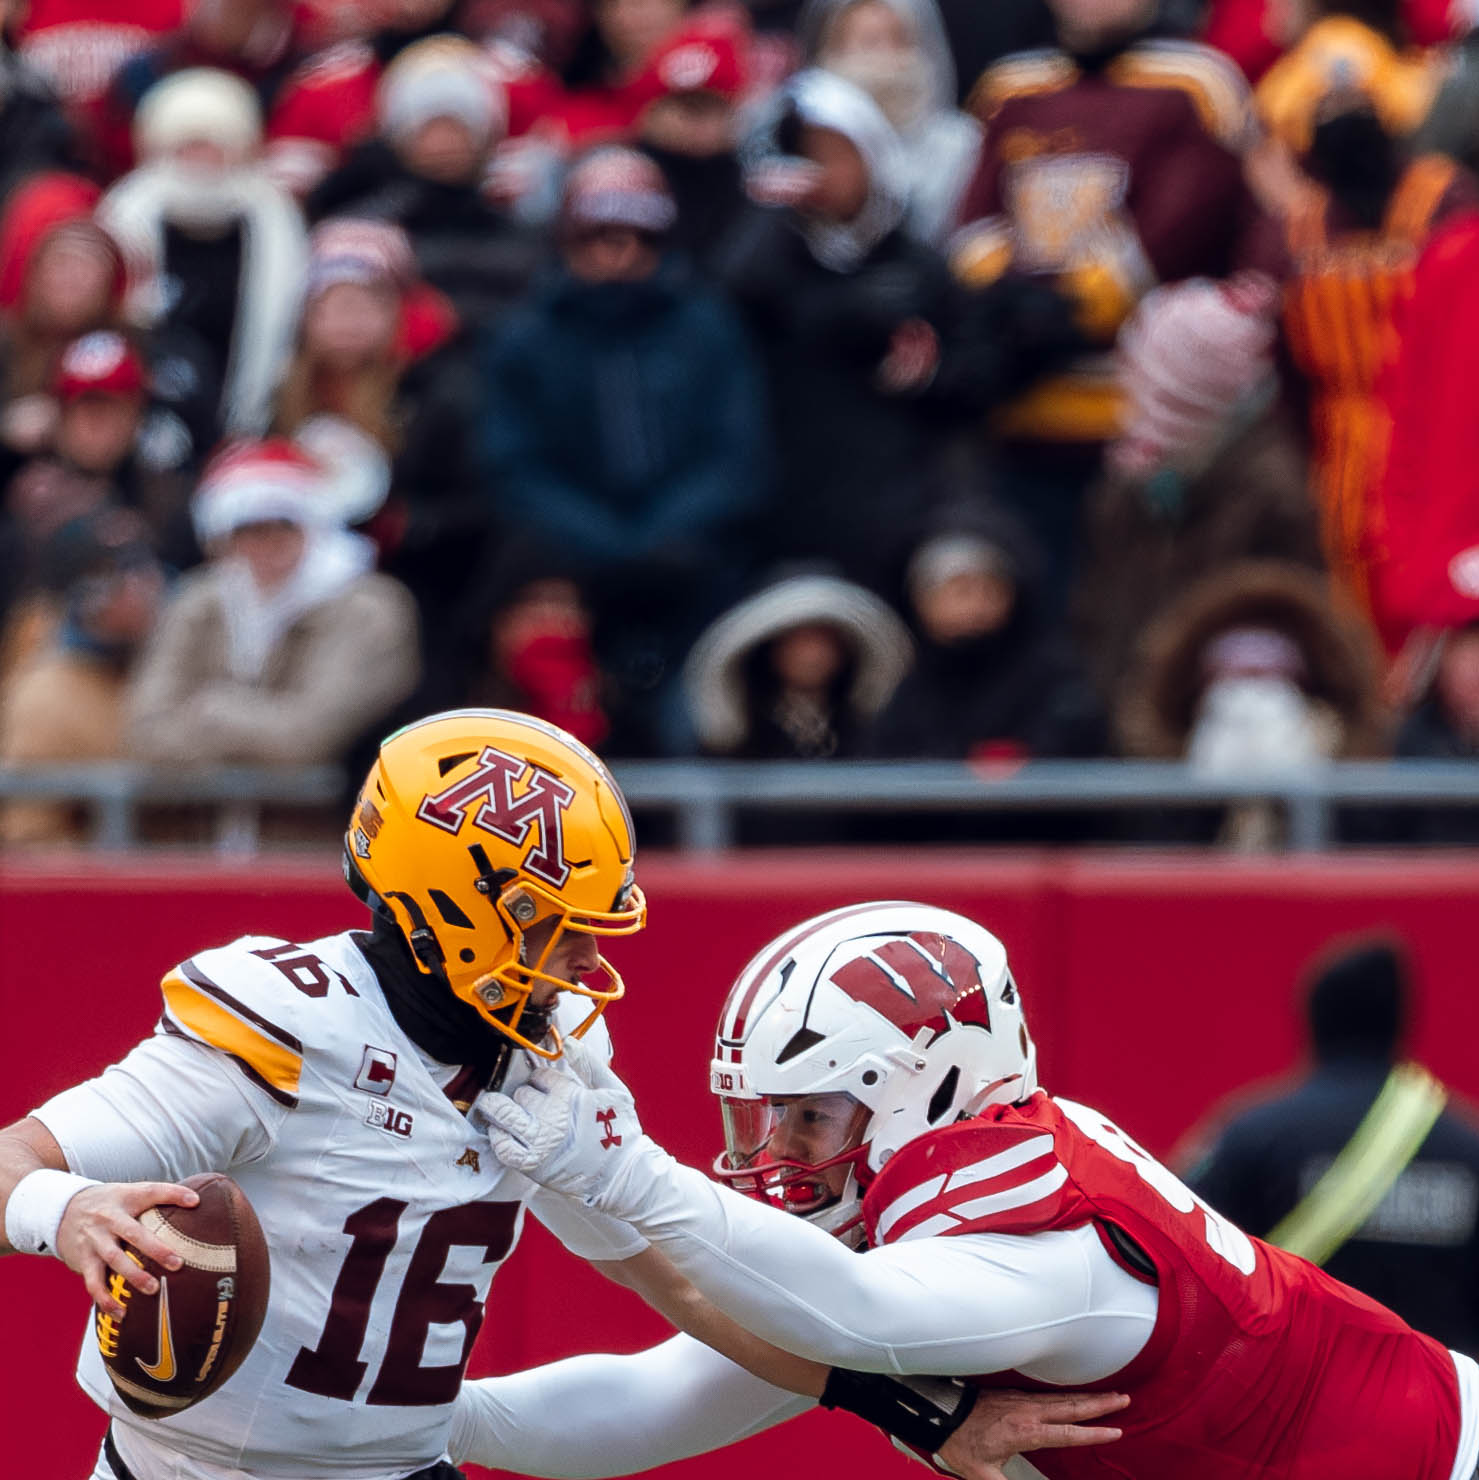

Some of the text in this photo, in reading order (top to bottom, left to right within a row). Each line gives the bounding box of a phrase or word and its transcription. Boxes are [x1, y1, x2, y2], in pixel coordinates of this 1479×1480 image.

[416, 746, 576, 890] M
[248, 943, 361, 998] 16
[829, 931, 992, 1050] W
[364, 1100, 413, 1138] BIG
[285, 1197, 524, 1407] 16
